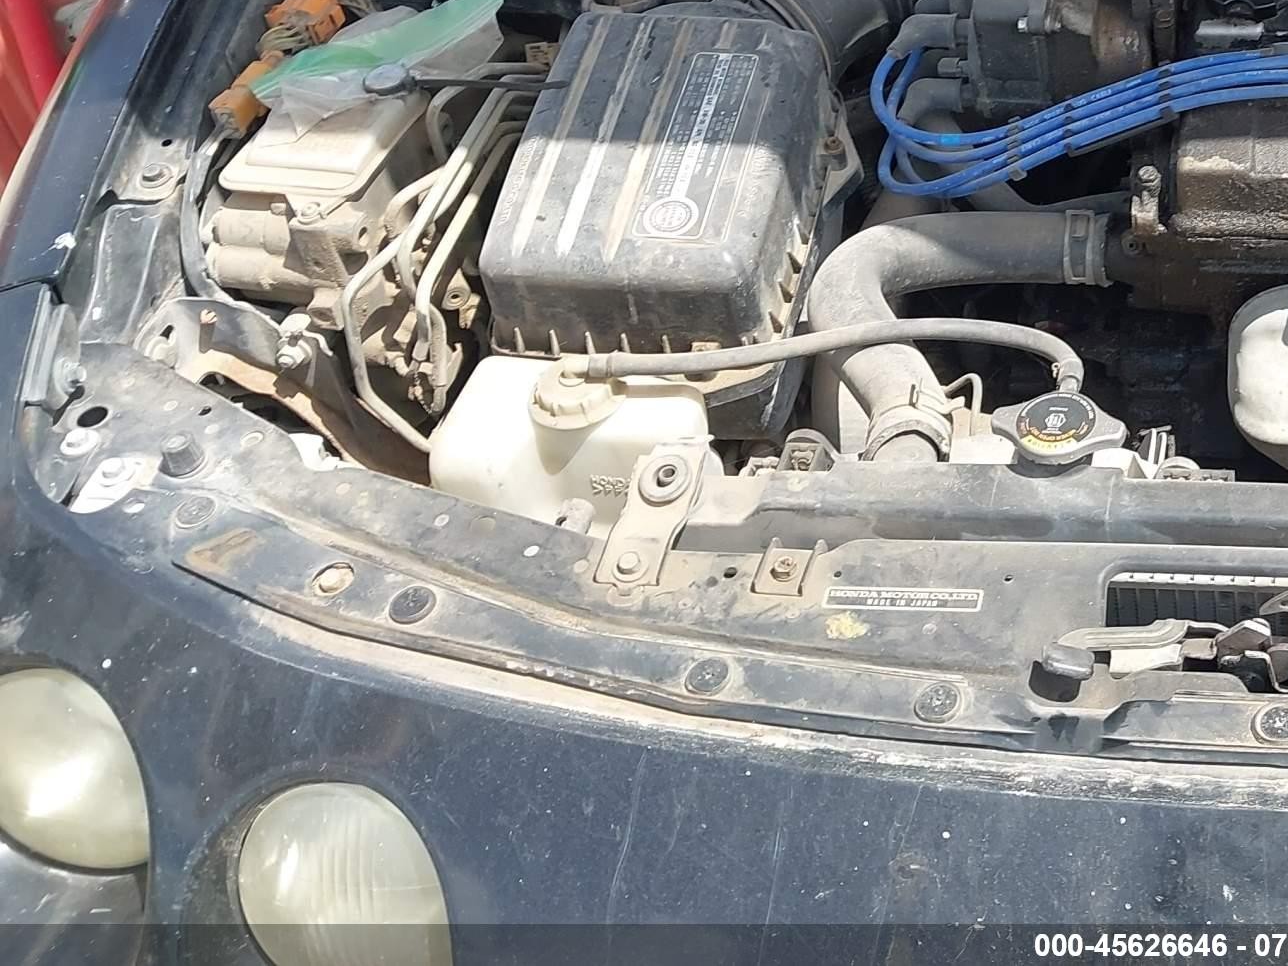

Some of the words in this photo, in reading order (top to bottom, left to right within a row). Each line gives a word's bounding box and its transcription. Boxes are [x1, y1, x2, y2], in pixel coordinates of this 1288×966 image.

[830, 589, 878, 599] HONDA
[880, 591, 930, 600] MOTOR
[866, 598, 891, 606] MADE
[895, 599, 905, 607] IN
[910, 599, 939, 607] JAPAN
